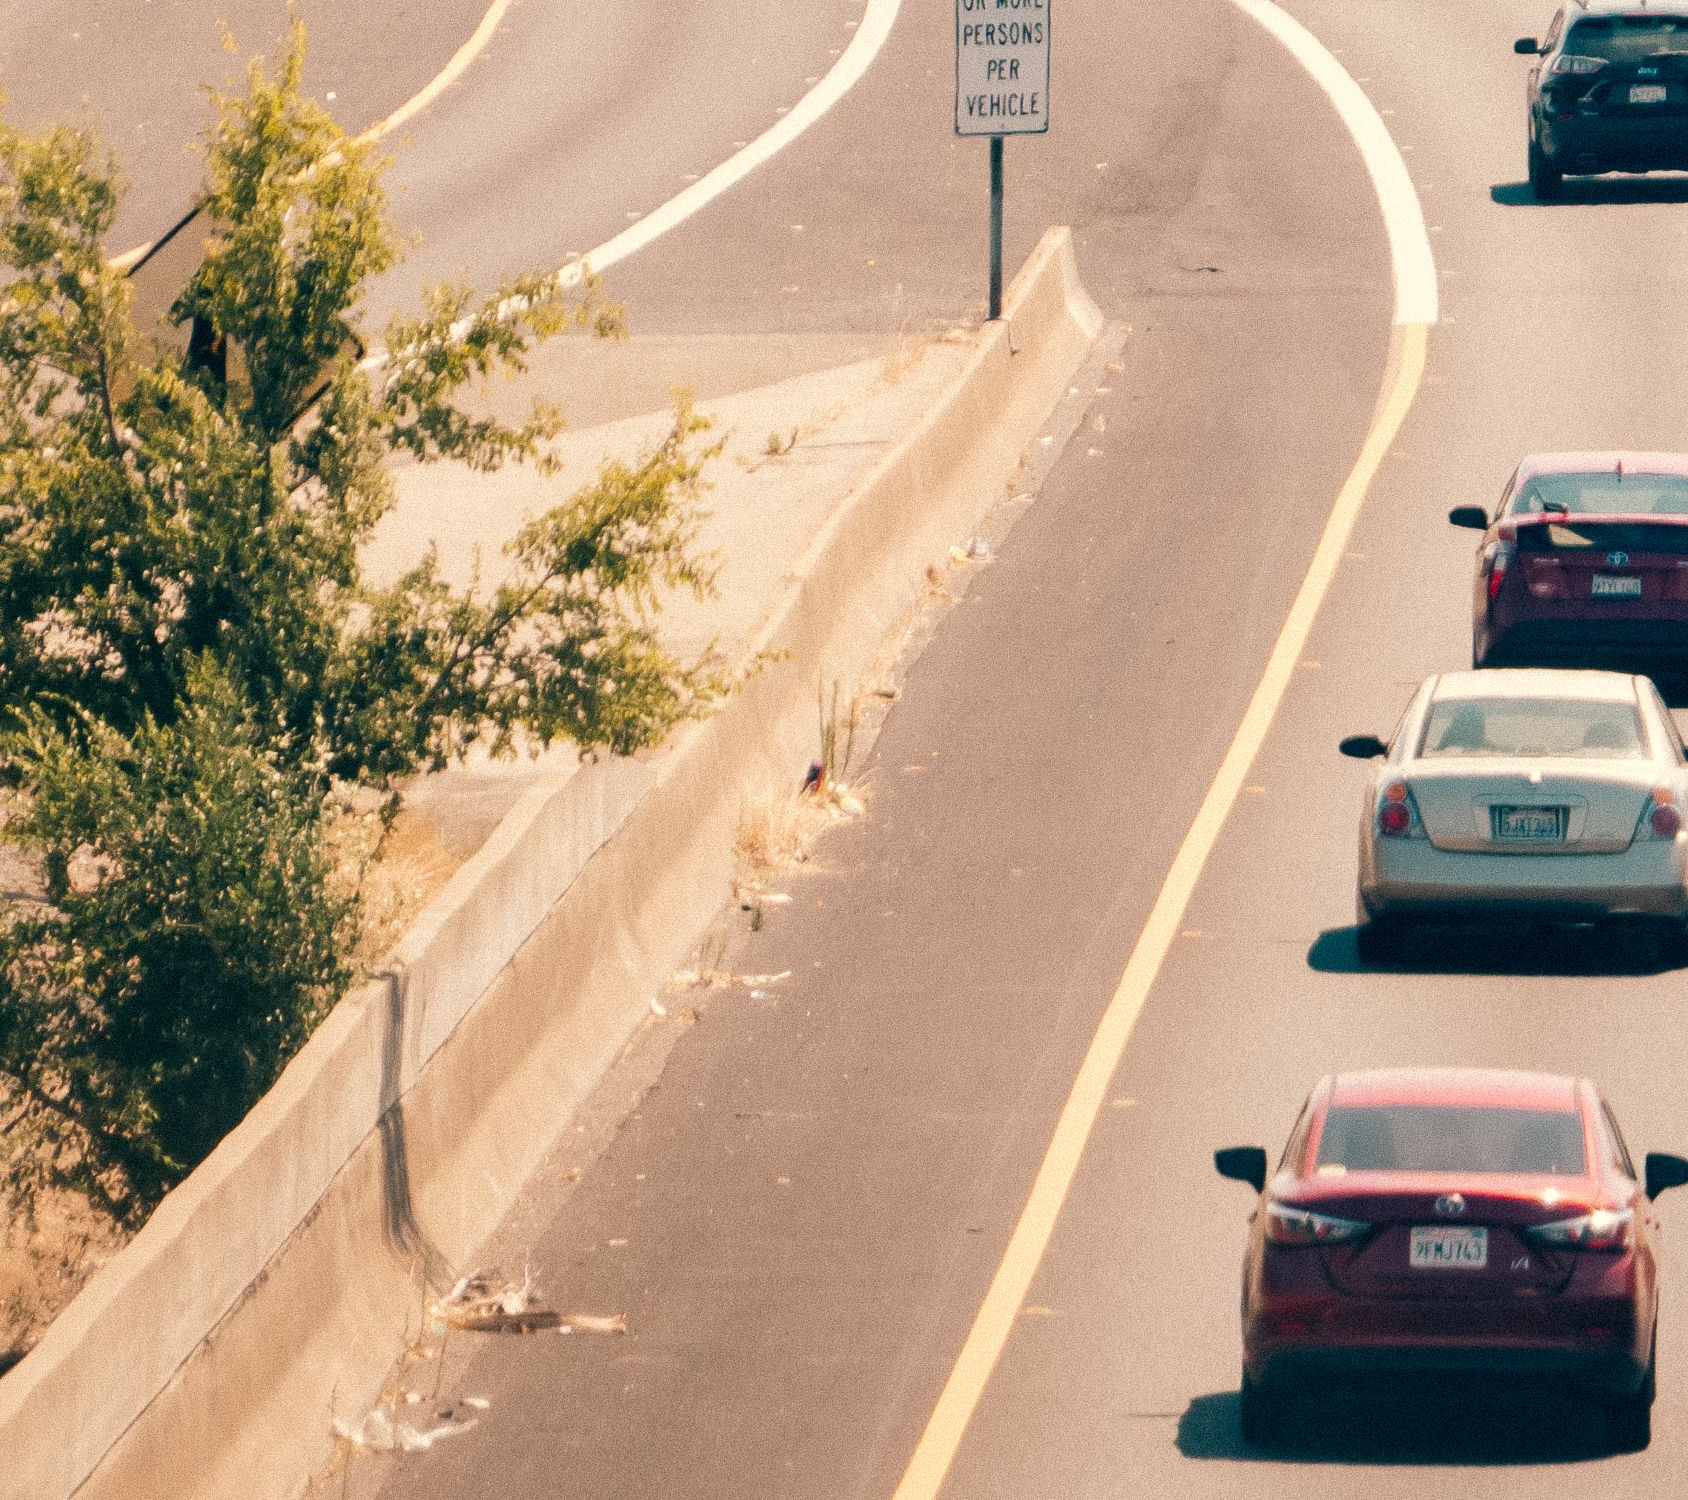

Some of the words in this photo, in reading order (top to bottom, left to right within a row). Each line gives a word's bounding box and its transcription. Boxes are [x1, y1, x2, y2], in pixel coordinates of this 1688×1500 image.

[963, 21, 1043, 46] PERSONS
[987, 58, 1020, 81] PER
[966, 91, 1039, 117] VEHICLE
